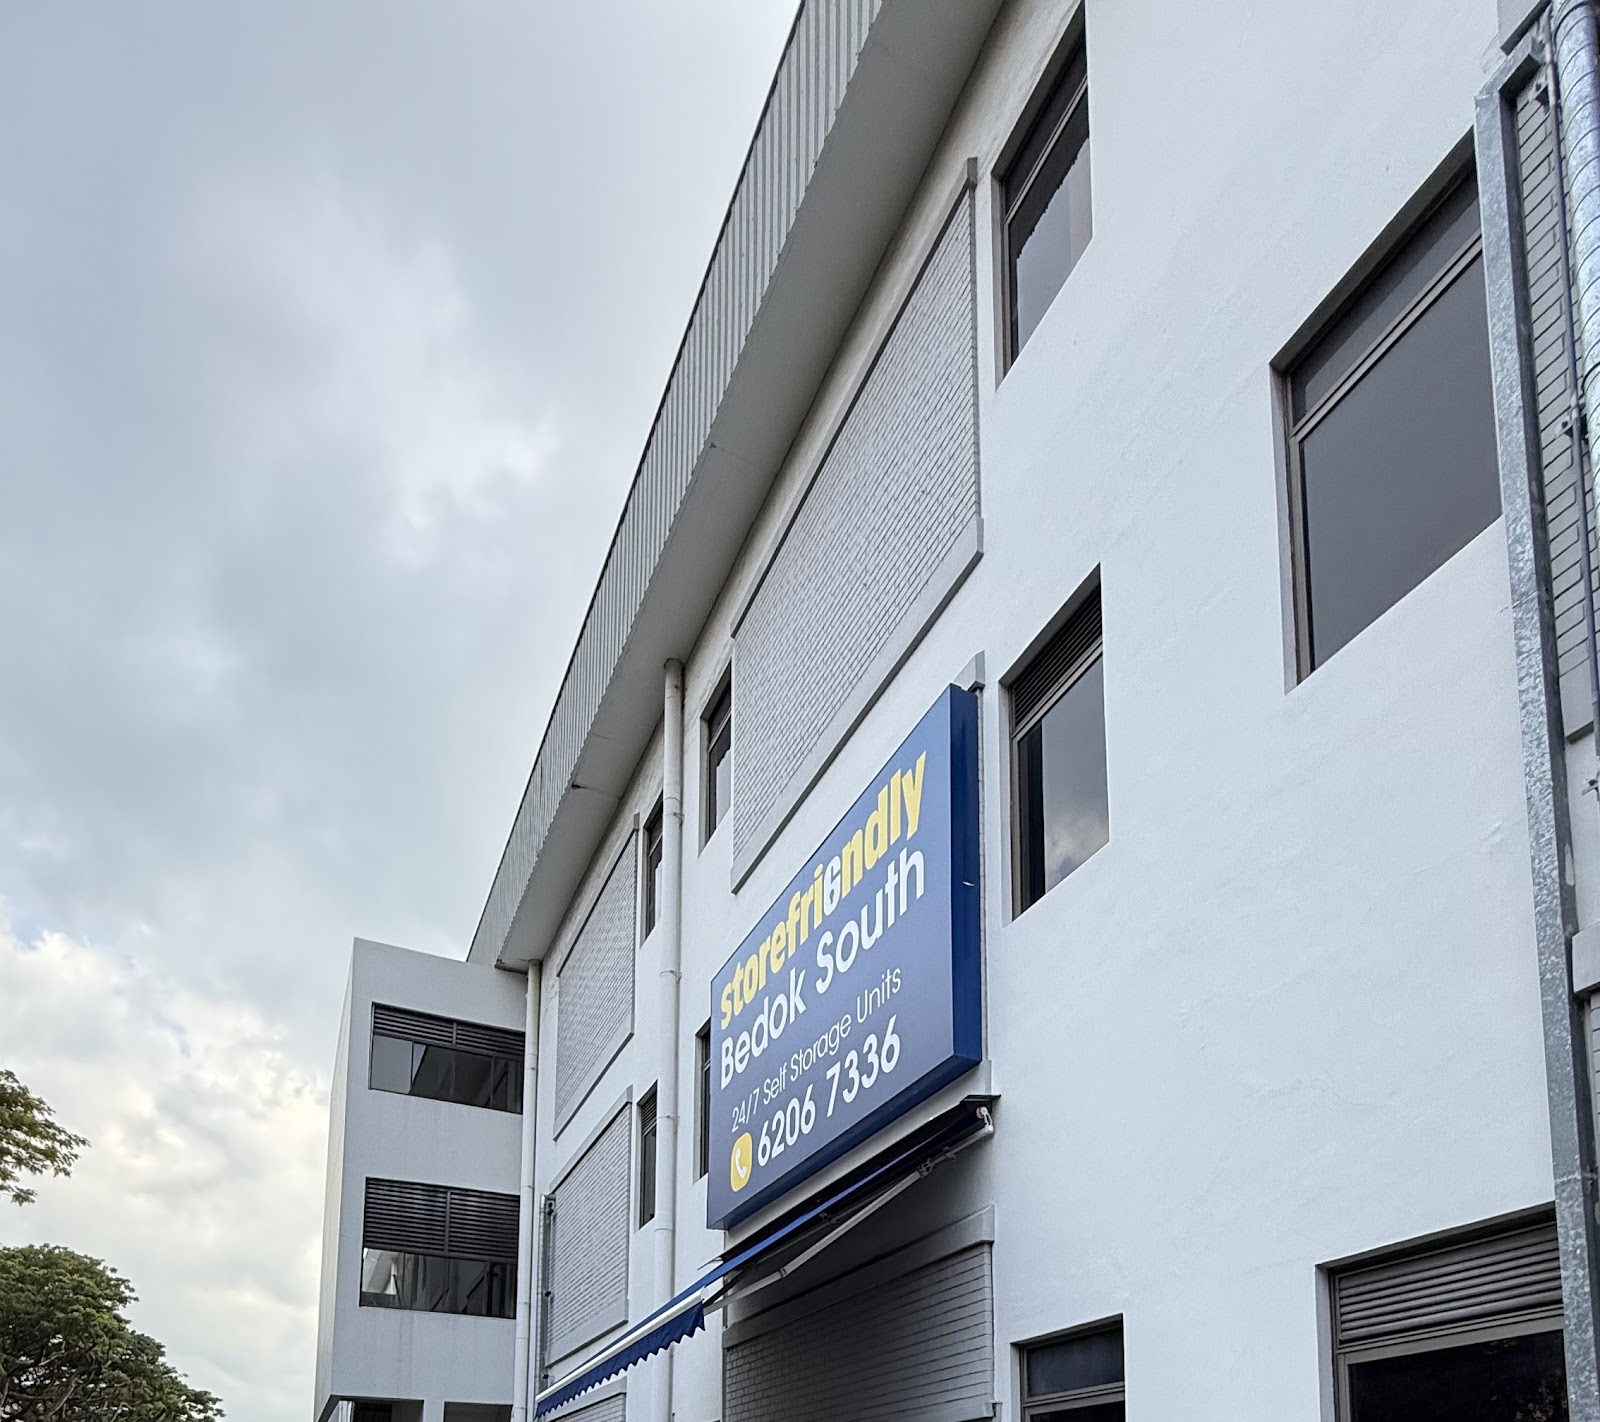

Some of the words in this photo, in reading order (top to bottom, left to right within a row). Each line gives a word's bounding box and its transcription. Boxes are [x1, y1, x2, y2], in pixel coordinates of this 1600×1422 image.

[720, 967, 807, 1091] Bedok
[815, 847, 925, 994] South
[731, 1086, 760, 1133] 24/7
[763, 1062, 788, 1105] Self
[790, 1013, 852, 1082] Storage
[857, 967, 901, 1024] Units
[757, 1083, 816, 1167] 6206
[826, 1014, 900, 1118] 7336
